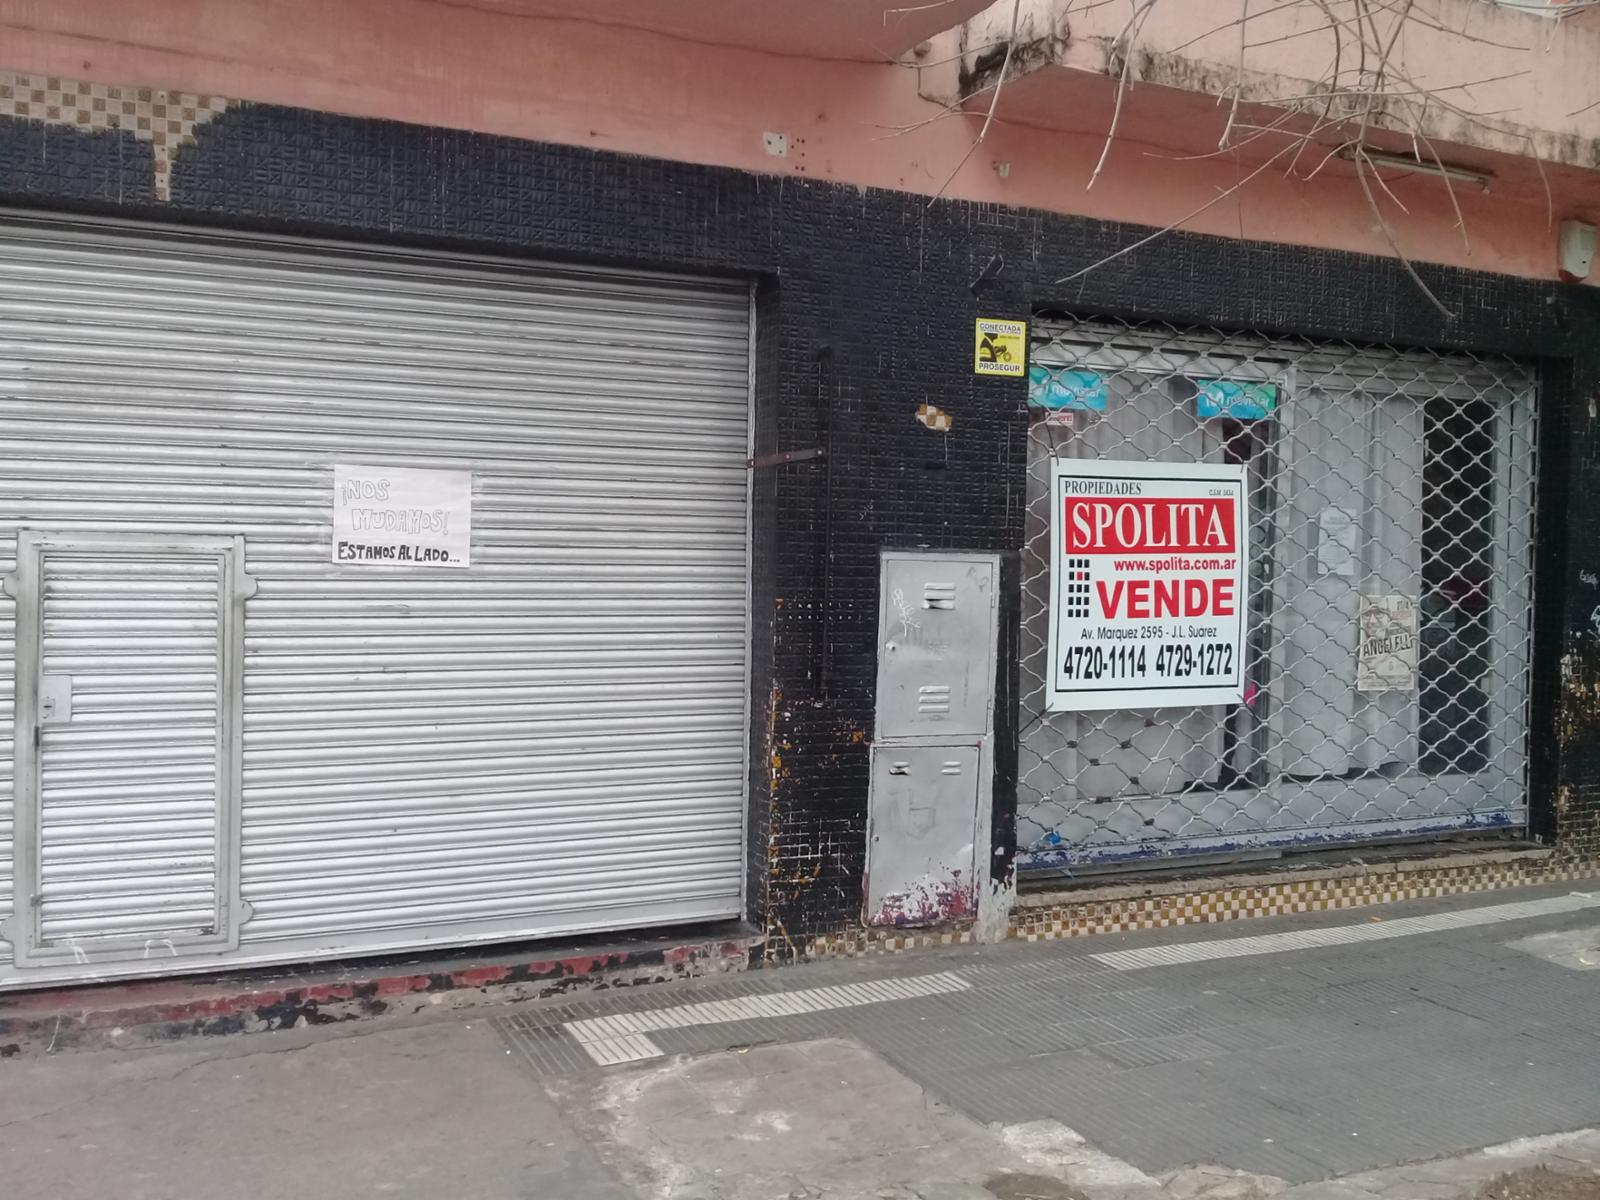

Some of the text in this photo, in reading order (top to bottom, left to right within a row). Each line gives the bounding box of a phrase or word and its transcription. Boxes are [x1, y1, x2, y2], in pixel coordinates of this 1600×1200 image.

[980, 323, 1021, 332] CONECTADA
[979, 362, 1020, 372] PROSEGUR
[1064, 480, 1142, 495] PROPIEDADES
[352, 508, 450, 535] MUDAMOS!
[1072, 502, 1229, 549] SPOLITA
[338, 541, 396, 560] ESTAMOS
[398, 544, 412, 560] AL
[1114, 557, 1237, 573] www.spolita.com.ar
[1096, 578, 1235, 619] VENDE
[1081, 628, 1095, 640] Av.
[1097, 627, 1138, 642] Marquez
[1141, 625, 1163, 639] 2595
[1171, 625, 1186, 639] J.L.
[1188, 625, 1217, 638] Suarez
[1063, 643, 1233, 680] 4720-1114 4729-1272
